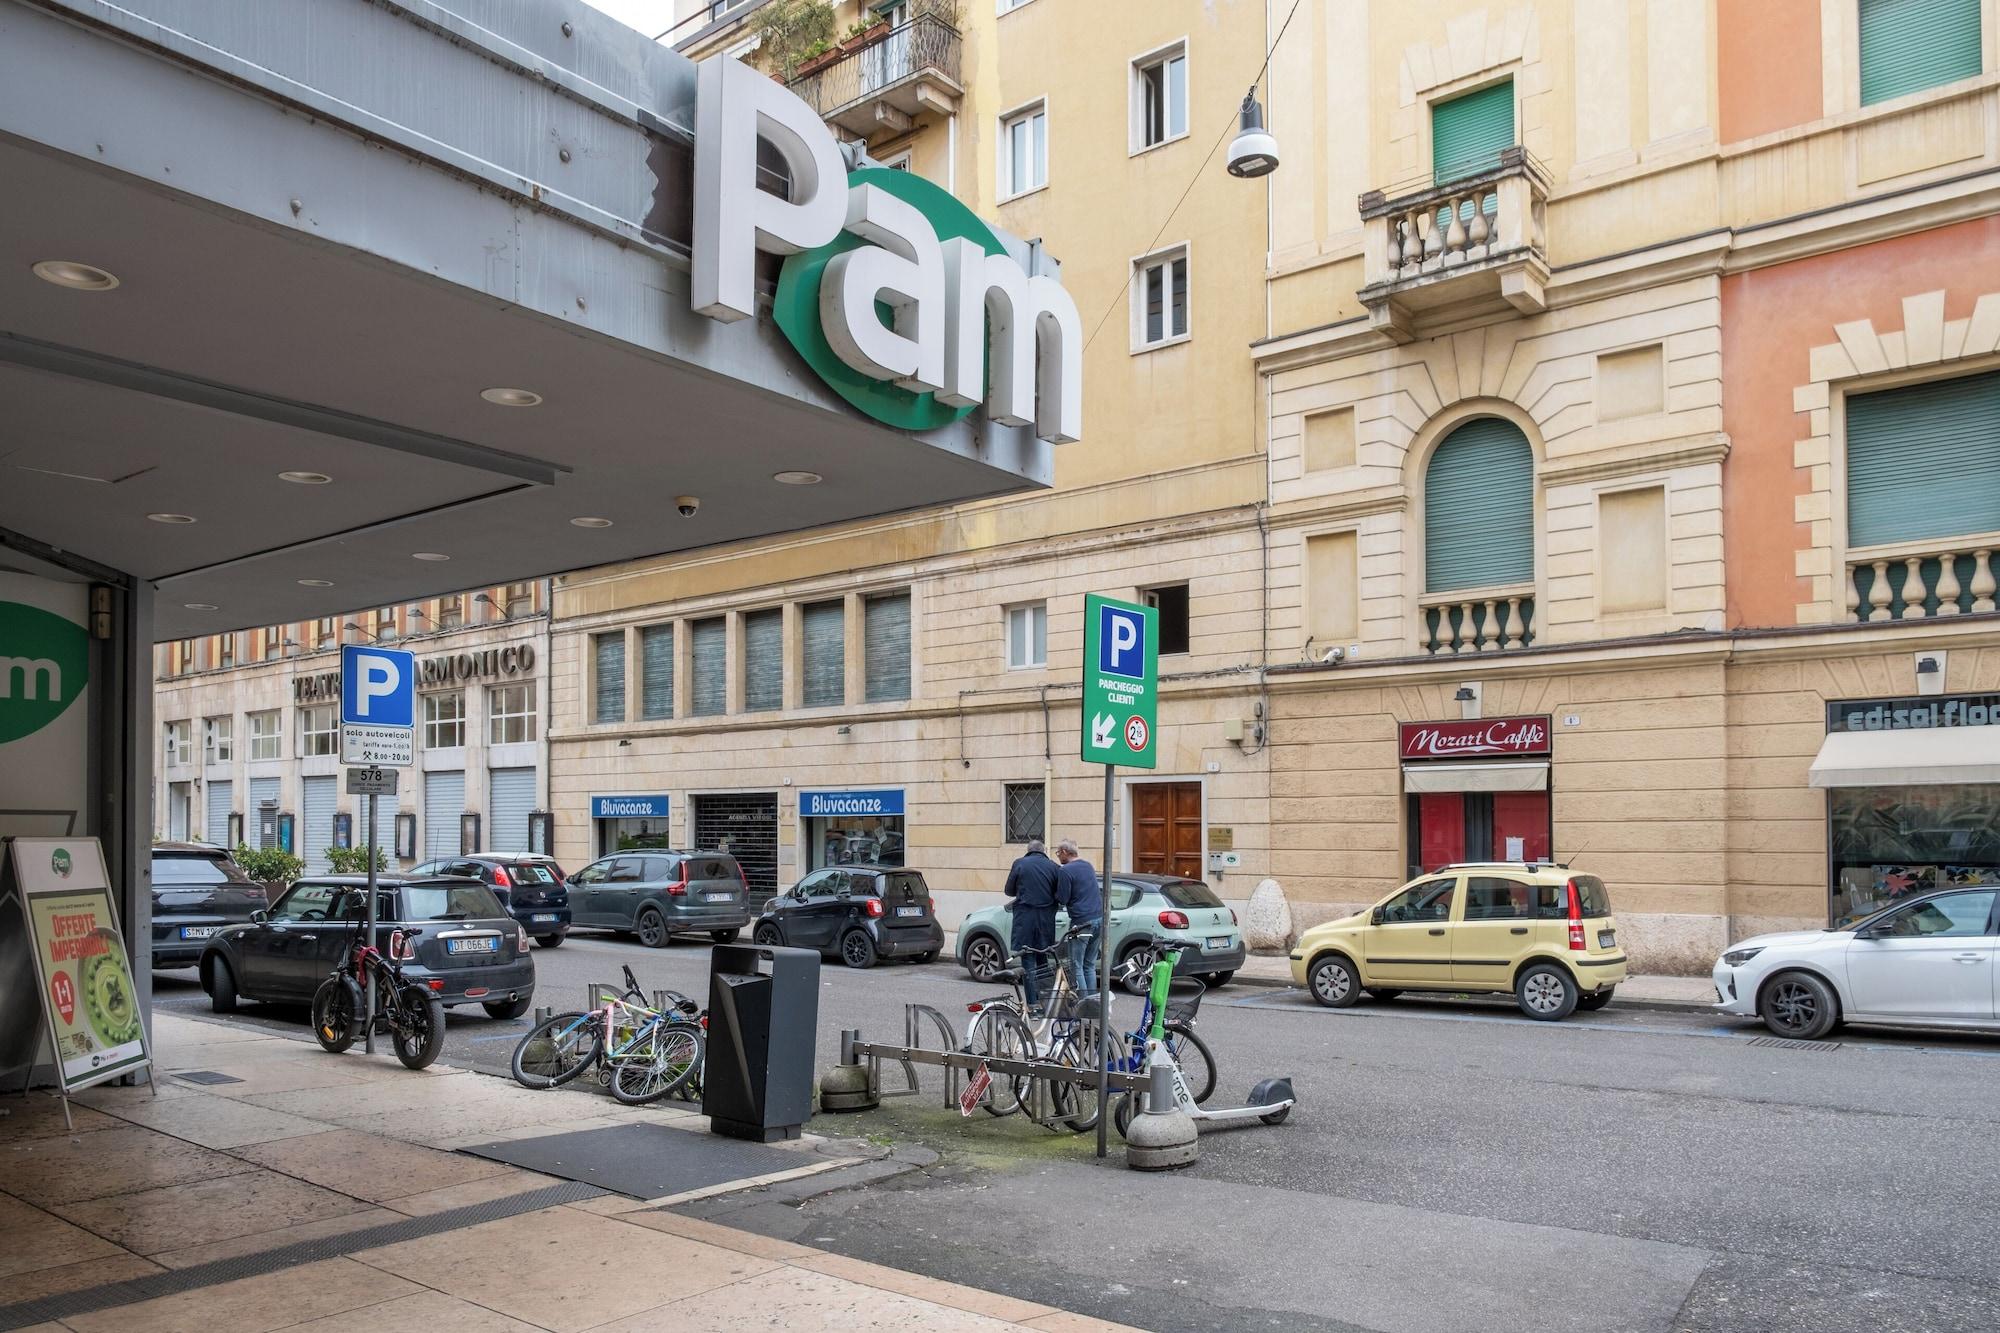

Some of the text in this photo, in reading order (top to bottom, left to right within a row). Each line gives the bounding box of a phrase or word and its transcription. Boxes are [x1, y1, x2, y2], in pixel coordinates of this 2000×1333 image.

[692, 52, 1082, 445] Pam
[1111, 615, 1137, 668] P
[292, 671, 341, 698] TEATR
[356, 654, 400, 717] P
[1098, 678, 1144, 695] PARCHEGGIO
[1108, 692, 1135, 705] CLIENTI
[345, 729, 410, 739] solo autoveicoli
[1406, 722, 1544, 754] Mozart Caffè
[360, 770, 382, 781] 578
[601, 799, 653, 815] Bluvacanze
[811, 795, 882, 814] Bluvacanze
[51, 913, 97, 938] OFFERTE
